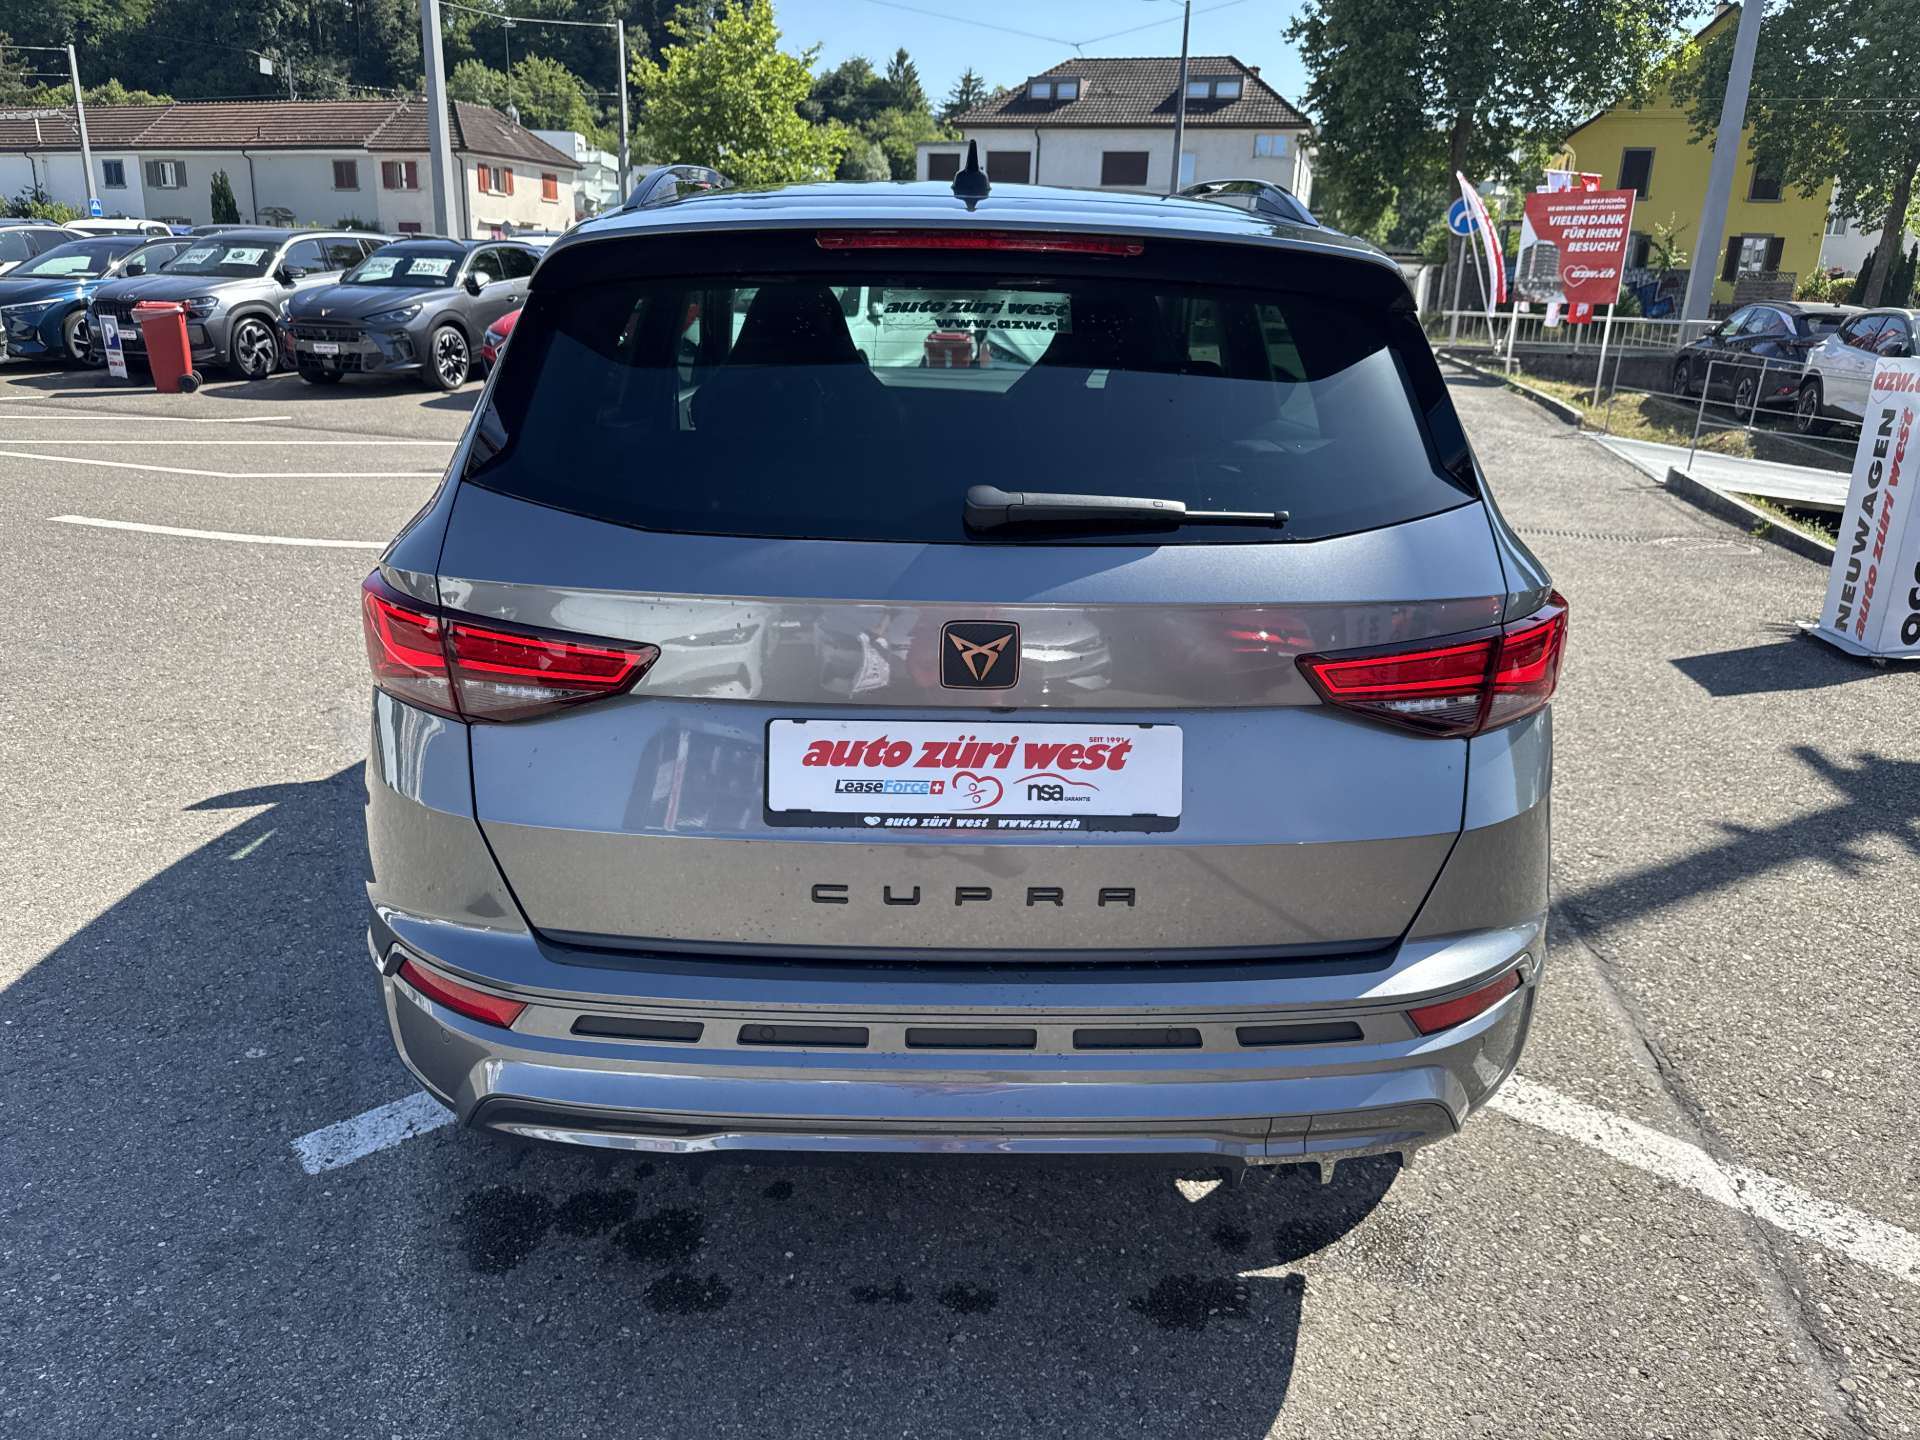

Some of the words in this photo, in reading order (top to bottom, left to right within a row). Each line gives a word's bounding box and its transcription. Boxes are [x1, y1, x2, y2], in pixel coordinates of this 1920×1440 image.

[1549, 215, 1588, 226] VIELEN
[1588, 214, 1625, 225] DANK
[1562, 227, 1586, 239] FÜR
[1586, 228, 1623, 239] IHREN
[1567, 241, 1621, 253] BESUCH!
[884, 300, 946, 314] auto
[946, 299, 1005, 314] züri
[1007, 301, 1071, 317] west
[105, 323, 115, 346] P
[1834, 408, 1897, 633] NEUWAGEN
[1855, 564, 1877, 641] auto
[1872, 488, 1895, 565] züri
[1888, 406, 1914, 487] west
[802, 734, 913, 768] auto
[913, 735, 1019, 769] züri
[1024, 738, 1133, 771] west
[835, 779, 930, 794] LeaseForce
[1027, 784, 1064, 801] nsa
[884, 816, 918, 827] auto
[920, 815, 952, 827] züri
[956, 816, 989, 828] west
[998, 817, 1081, 829] www.azw.ch
[811, 884, 1136, 907] CUPRA
